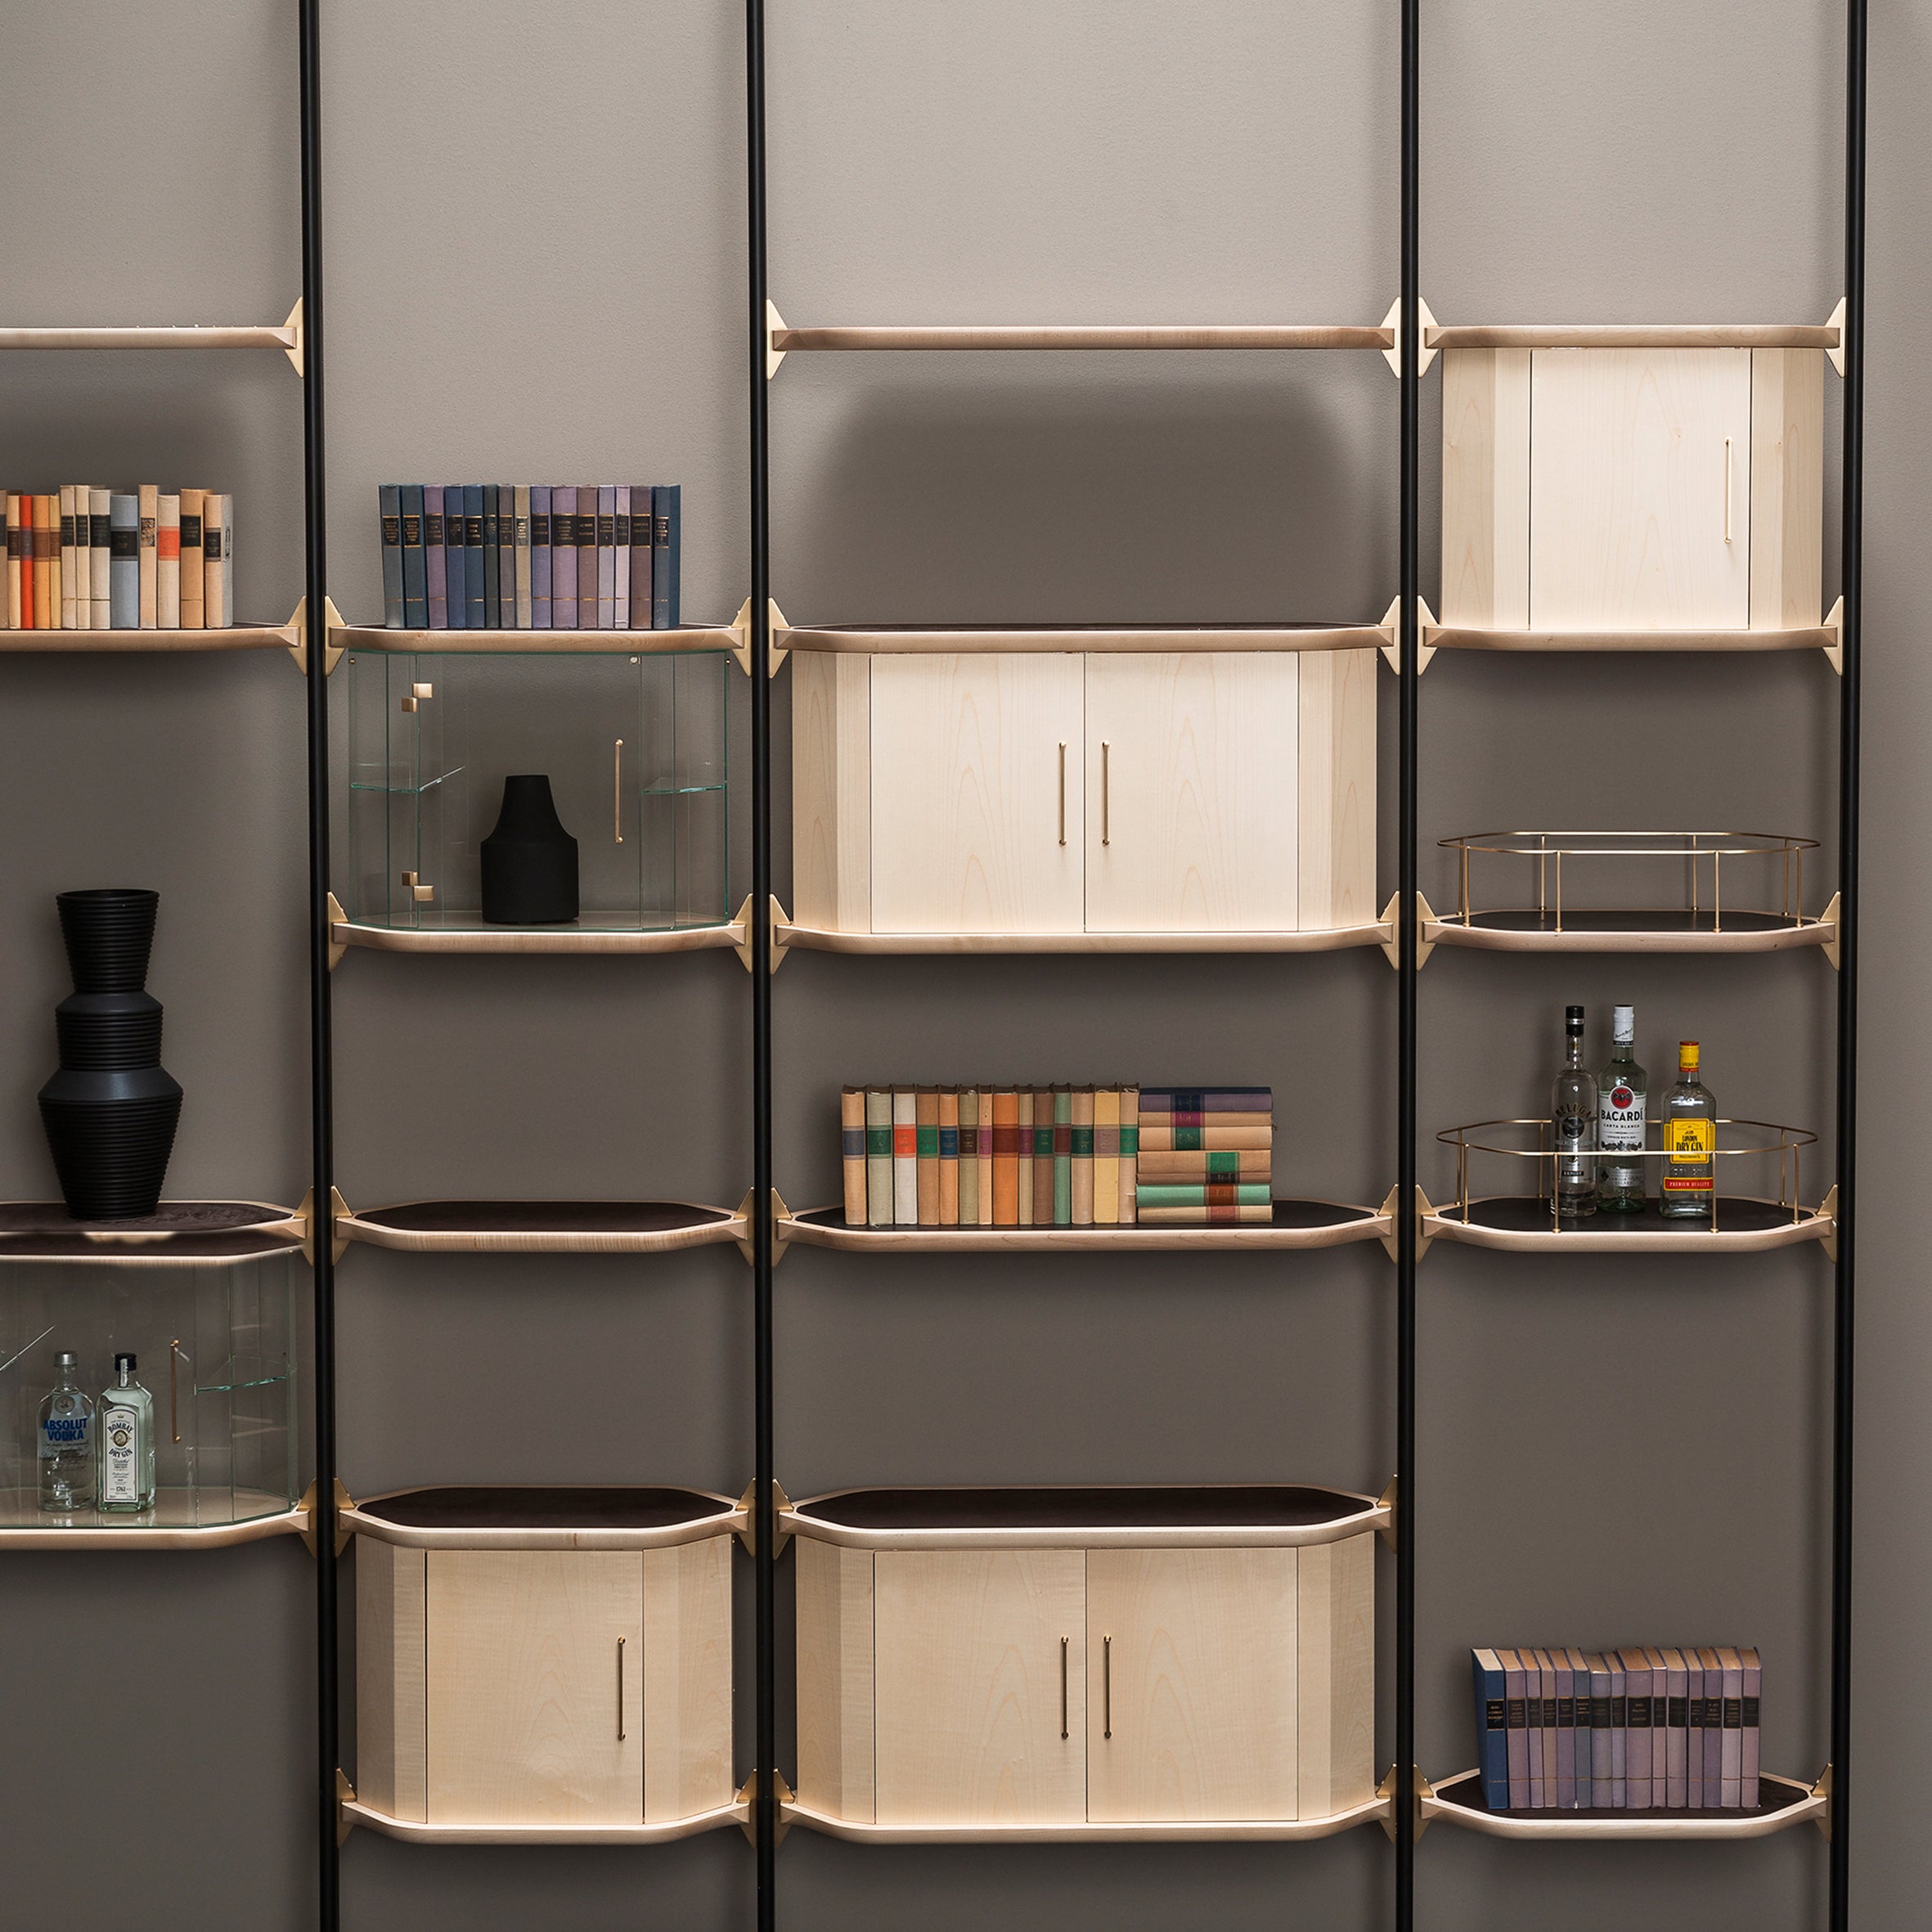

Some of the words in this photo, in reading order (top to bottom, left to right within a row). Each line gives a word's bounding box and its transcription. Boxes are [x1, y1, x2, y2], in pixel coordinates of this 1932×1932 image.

[1601, 1107, 1643, 1121] BACARDÍ
[43, 1418, 88, 1431] ABSOLUT
[107, 1422, 134, 1433] BOMBAY
[47, 1429, 84, 1441] VODKA
[109, 1448, 120, 1458] DRY
[121, 1448, 133, 1458] GIN
